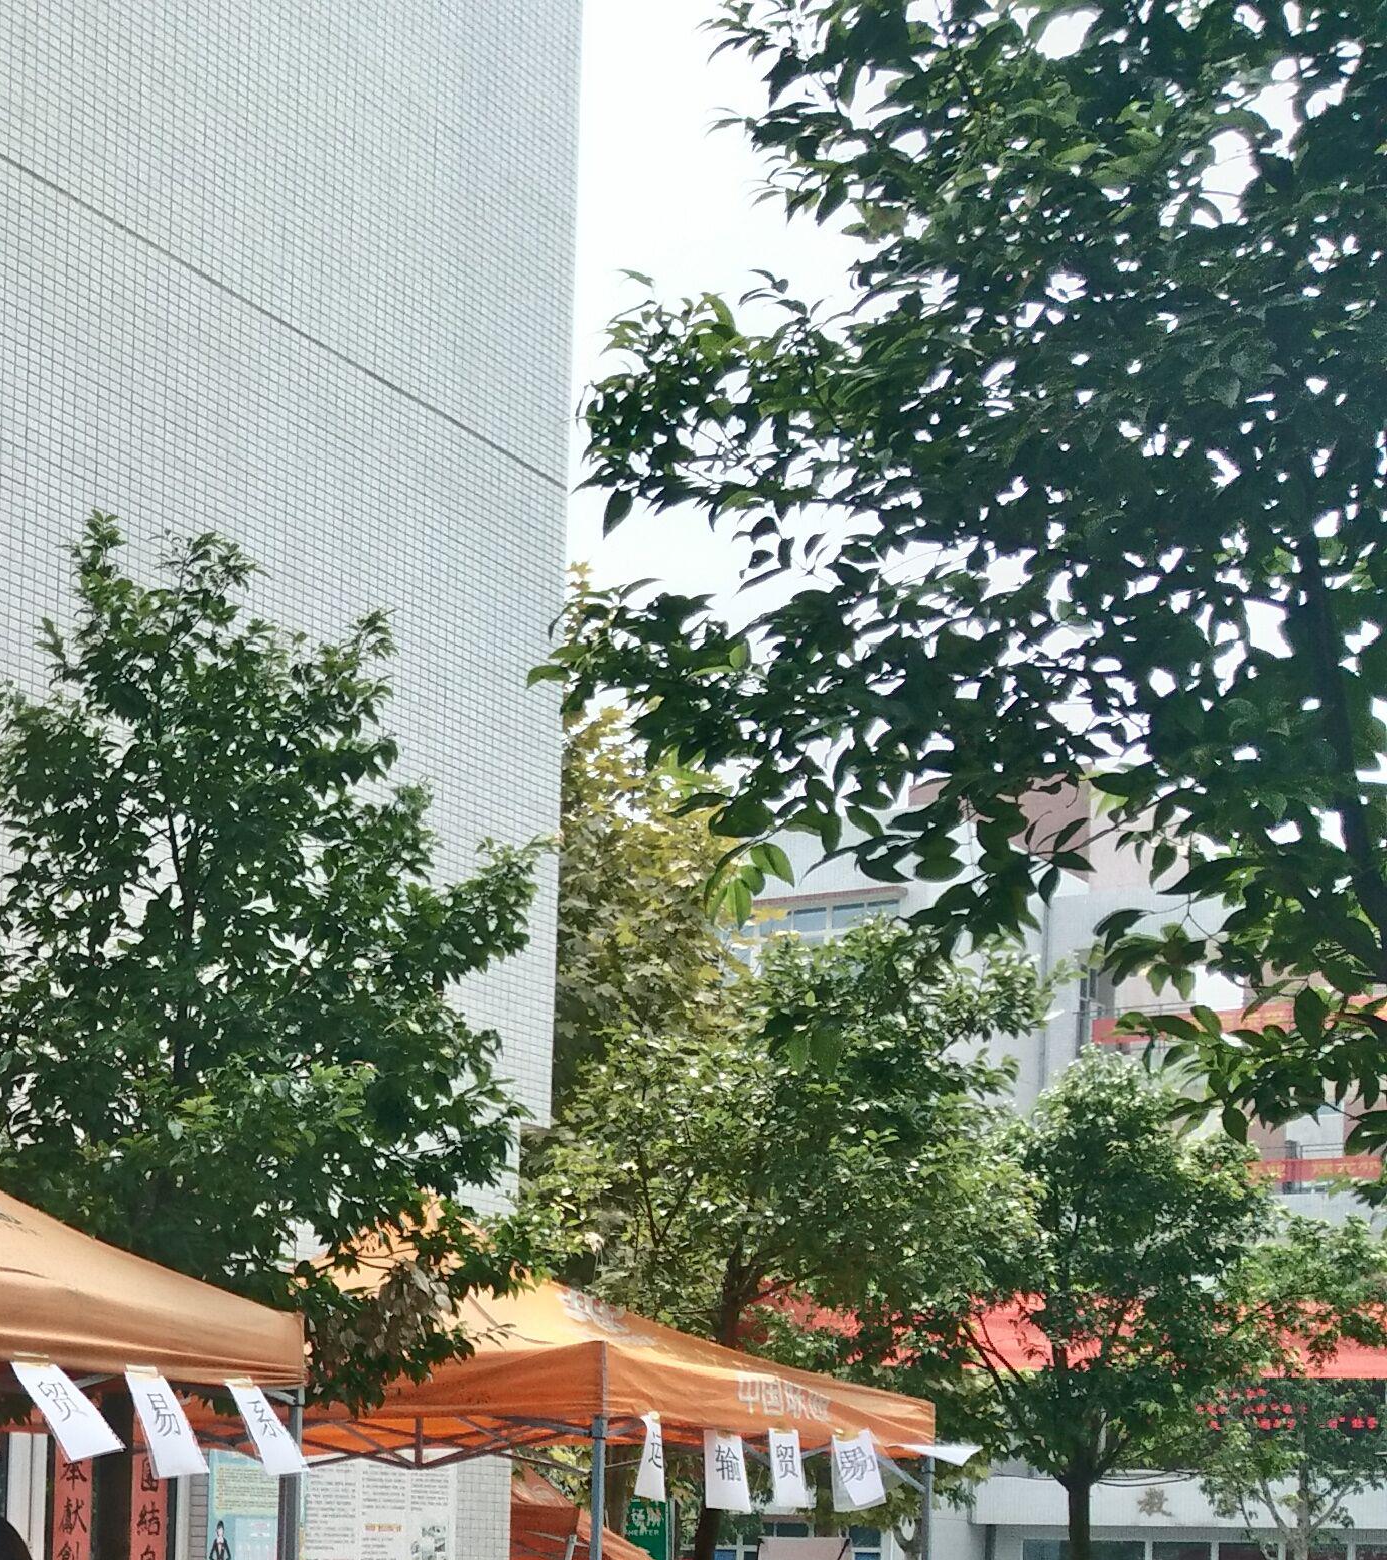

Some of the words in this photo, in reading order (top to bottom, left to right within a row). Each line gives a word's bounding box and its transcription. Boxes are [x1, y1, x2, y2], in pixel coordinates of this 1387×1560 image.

[38, 1381, 89, 1422] 贸
[146, 1393, 182, 1437] 易
[247, 1400, 283, 1438] 系
[715, 1444, 744, 1481] 输
[777, 1444, 799, 1479] 贸
